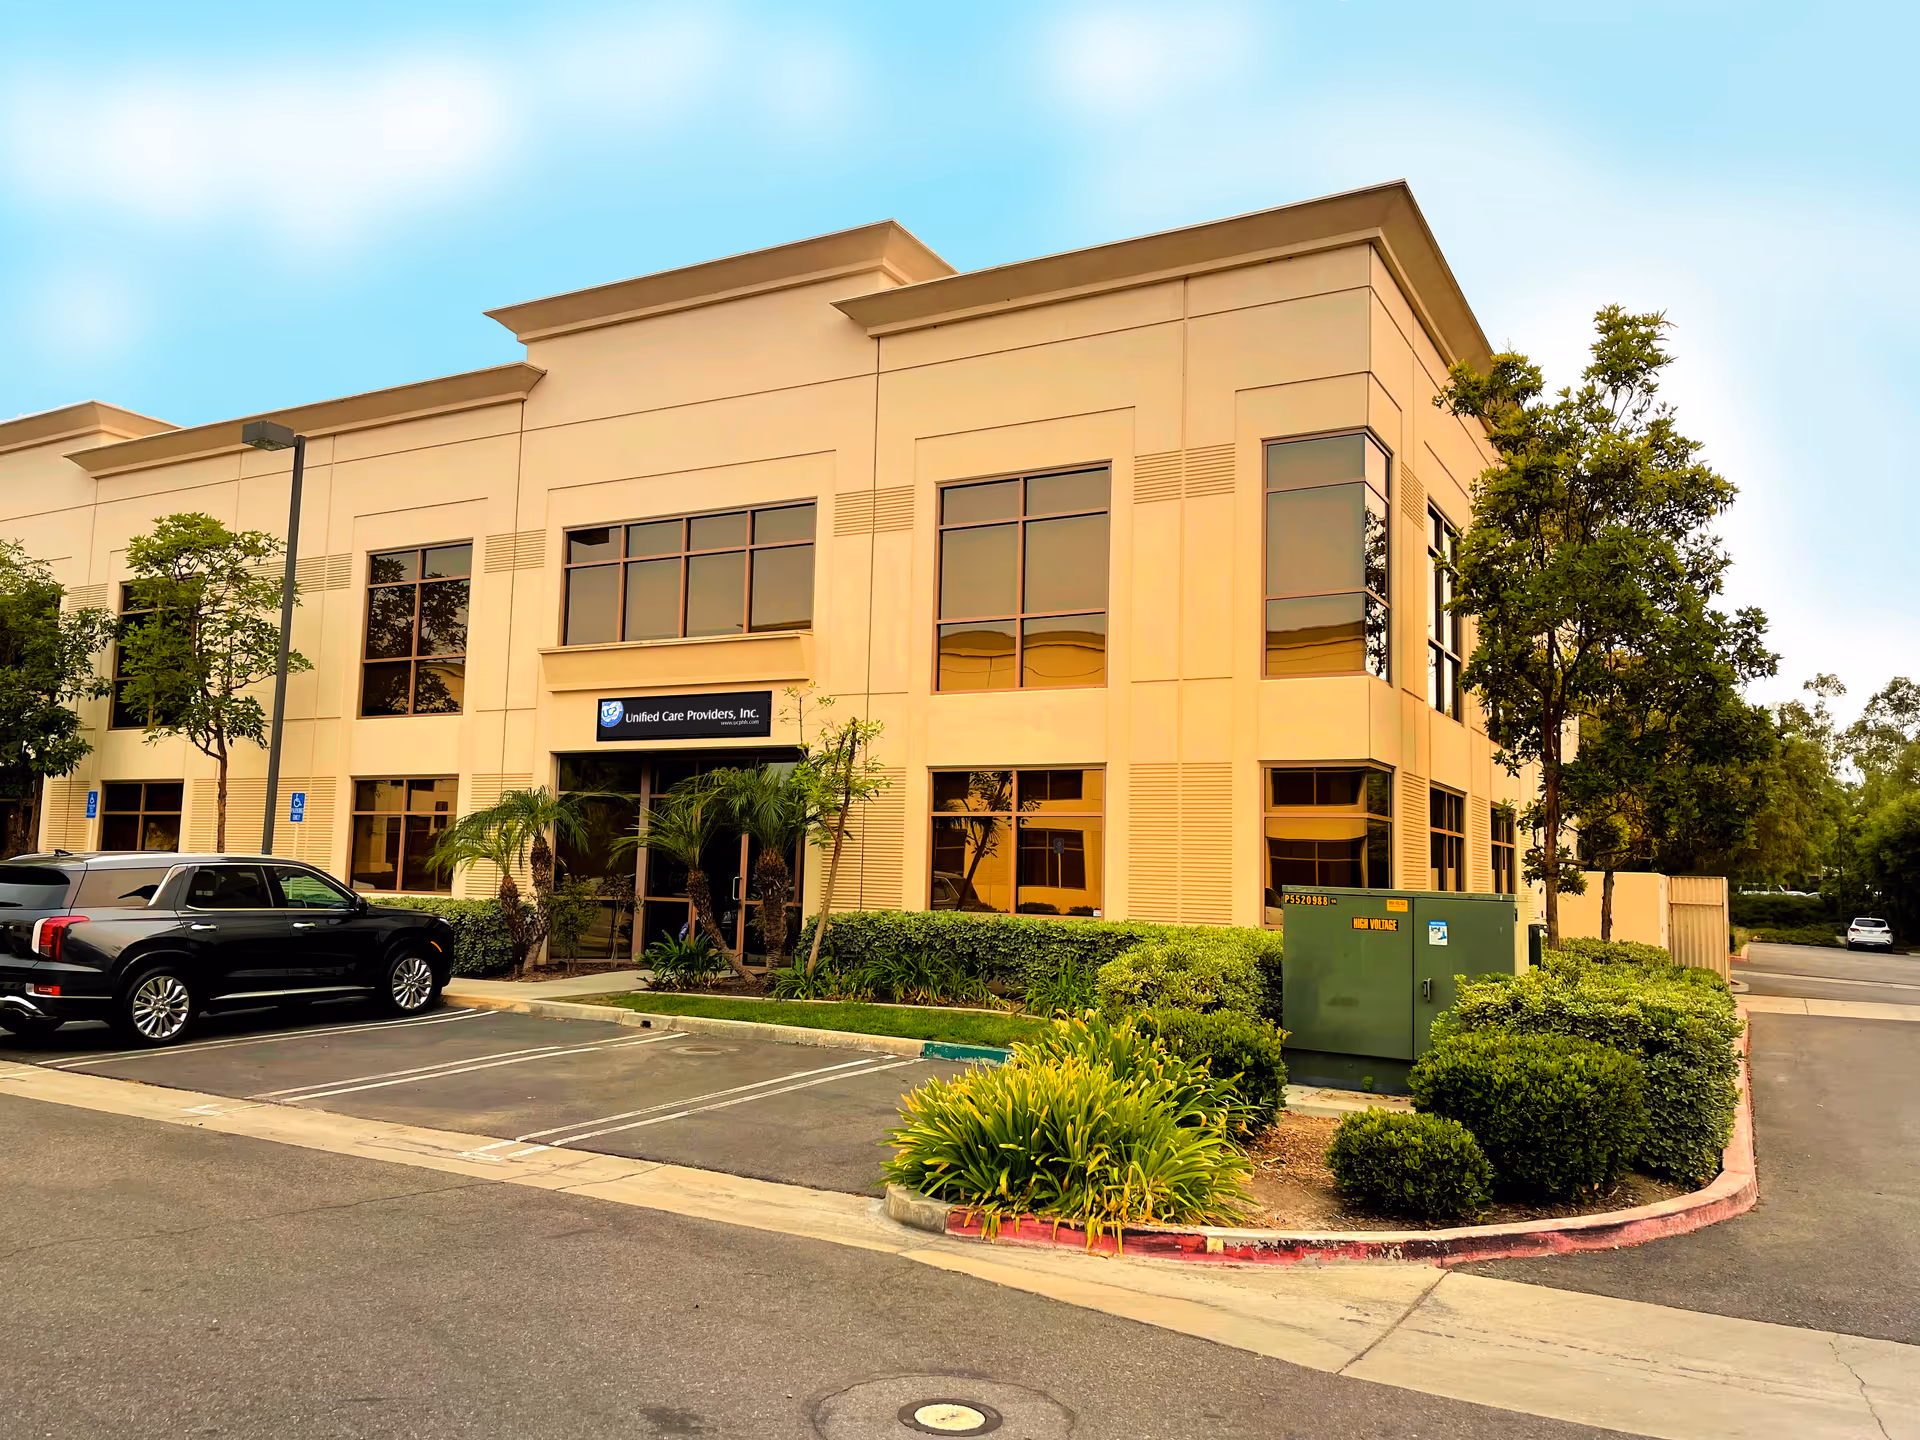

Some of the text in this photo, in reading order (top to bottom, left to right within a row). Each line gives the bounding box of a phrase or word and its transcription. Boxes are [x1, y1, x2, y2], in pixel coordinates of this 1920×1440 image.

[625, 711, 660, 723] Unified
[662, 710, 684, 722] Care
[687, 708, 737, 721] Providers,
[740, 707, 760, 718] Inc.
[1284, 894, 1328, 906] P5520988
[1353, 917, 1397, 931] HIGH VOLTAGE
